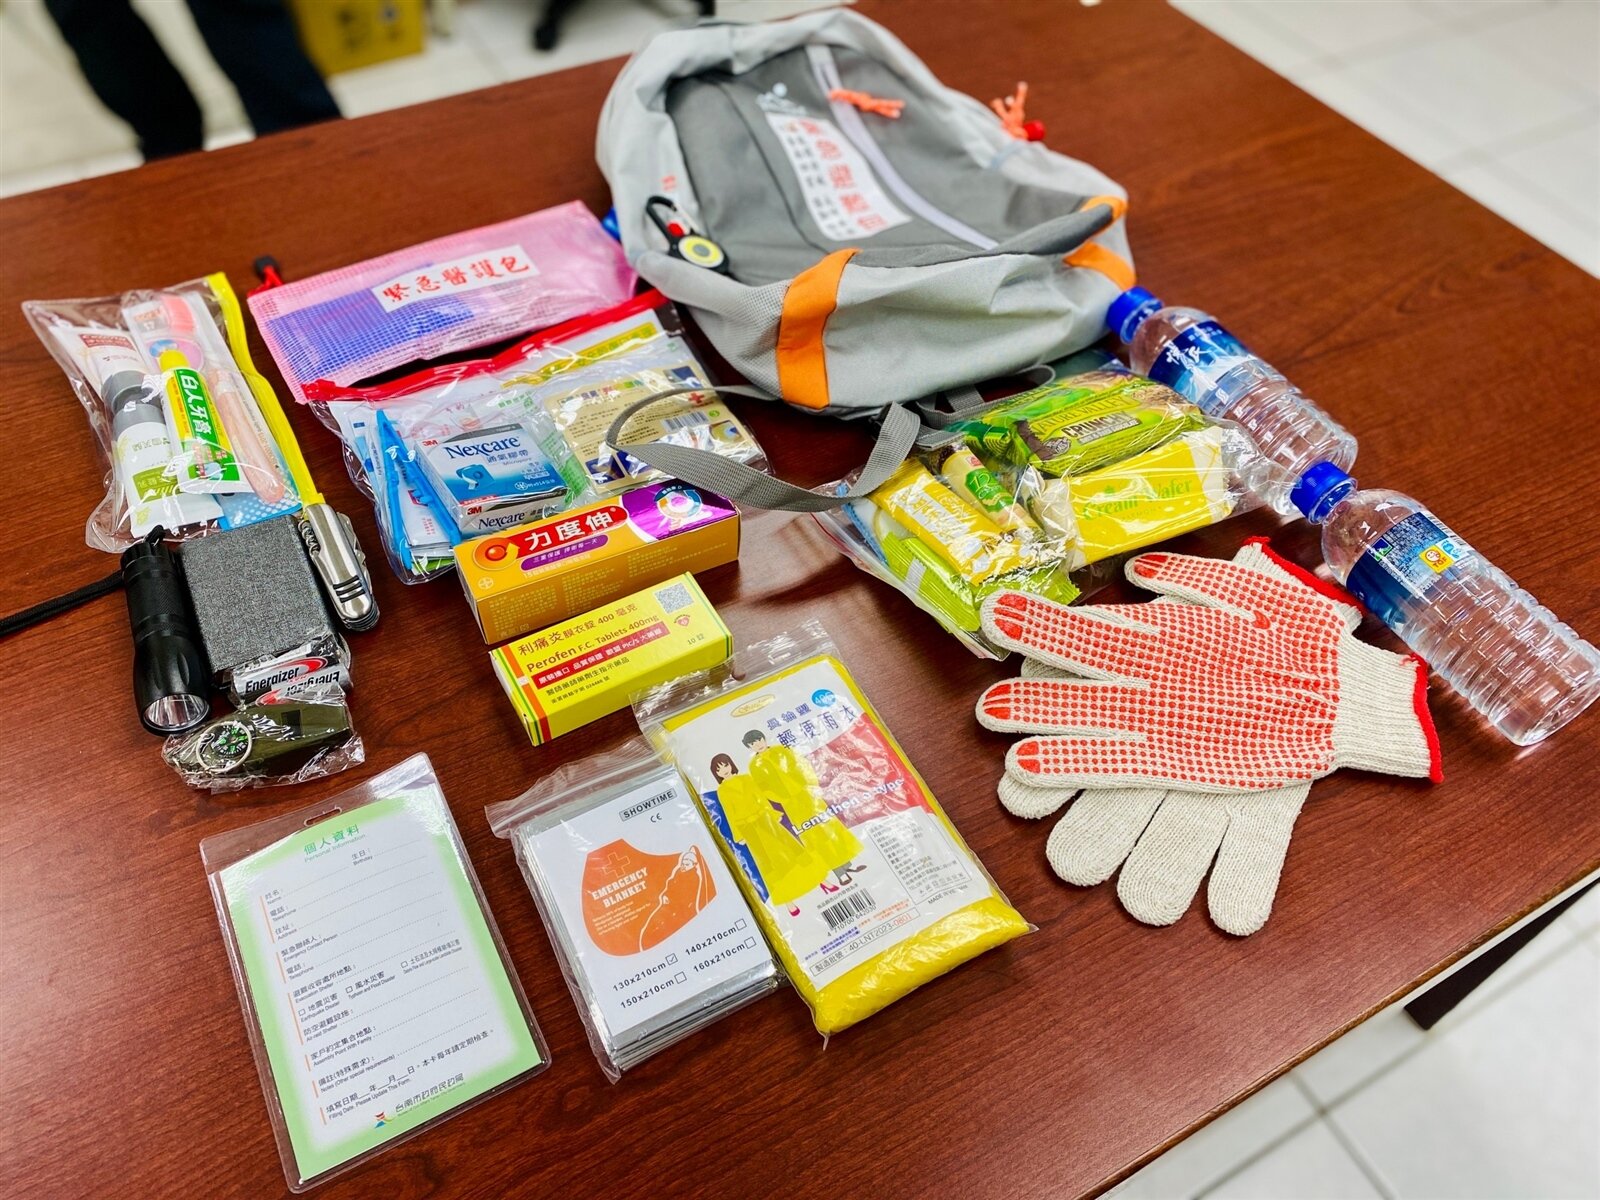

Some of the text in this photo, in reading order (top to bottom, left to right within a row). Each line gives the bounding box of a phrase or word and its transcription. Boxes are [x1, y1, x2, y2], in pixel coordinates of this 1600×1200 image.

[382, 255, 530, 303] 緊急醫護包
[180, 375, 212, 435] 白人牙膏
[422, 439, 438, 447] 3M
[444, 436, 521, 459] Nexcare
[467, 506, 482, 515] 3M
[478, 511, 525, 530] Nexcare
[525, 512, 614, 551] 力度伸
[597, 613, 615, 625] 400
[526, 647, 577, 673] Perofen
[577, 641, 595, 652] F.C.
[595, 627, 628, 645] Tablets
[628, 614, 660, 630] 400mg
[245, 667, 300, 693] Energizer
[776, 705, 858, 749] 輕便雨衣
[622, 790, 675, 819] SHOWTIME
[650, 813, 663, 824] CE
[304, 824, 360, 855] 個人資料
[304, 848, 331, 863] Personal
[591, 867, 648, 901] EMERGENCY
[602, 880, 647, 908] BLANKET
[928, 893, 943, 904] MADE
[833, 917, 855, 933] 710700
[685, 927, 737, 956] 140x210cm
[693, 943, 746, 973] 160x210cm
[612, 963, 667, 993] 130x210cm
[620, 979, 675, 1009] 150x210cm
[320, 1084, 335, 1093] Notes
[388, 1084, 399, 1093] This
